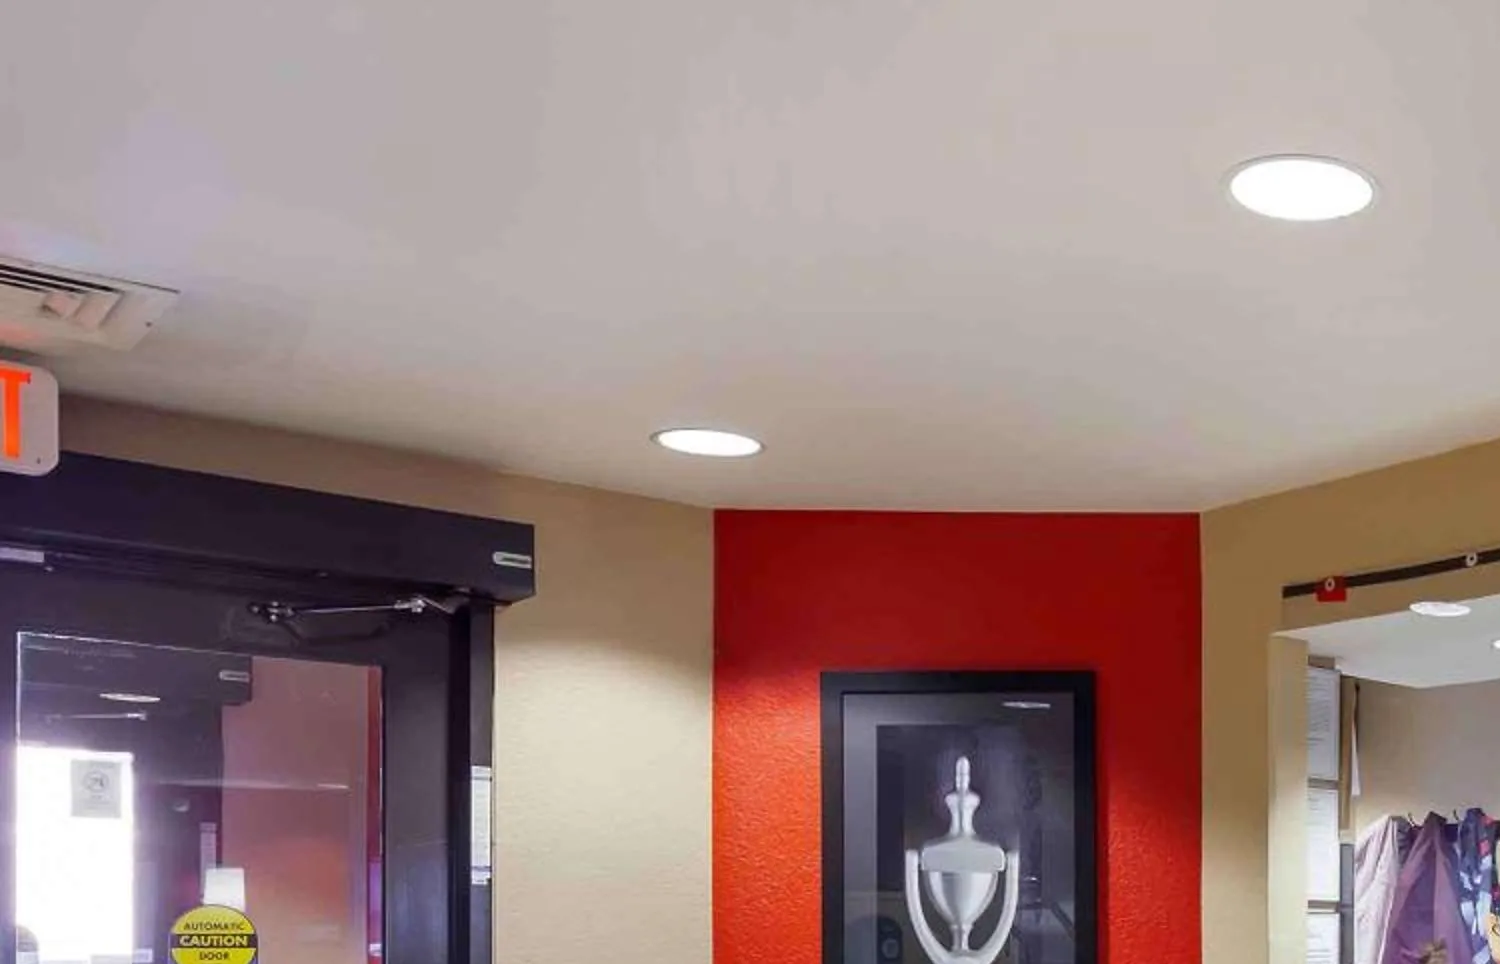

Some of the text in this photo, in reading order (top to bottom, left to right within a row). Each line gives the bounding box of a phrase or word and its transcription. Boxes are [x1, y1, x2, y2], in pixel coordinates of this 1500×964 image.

[183, 921, 245, 931] AUTOMATIC
[180, 935, 248, 947] CAUTION
[199, 952, 229, 960] DOOR
